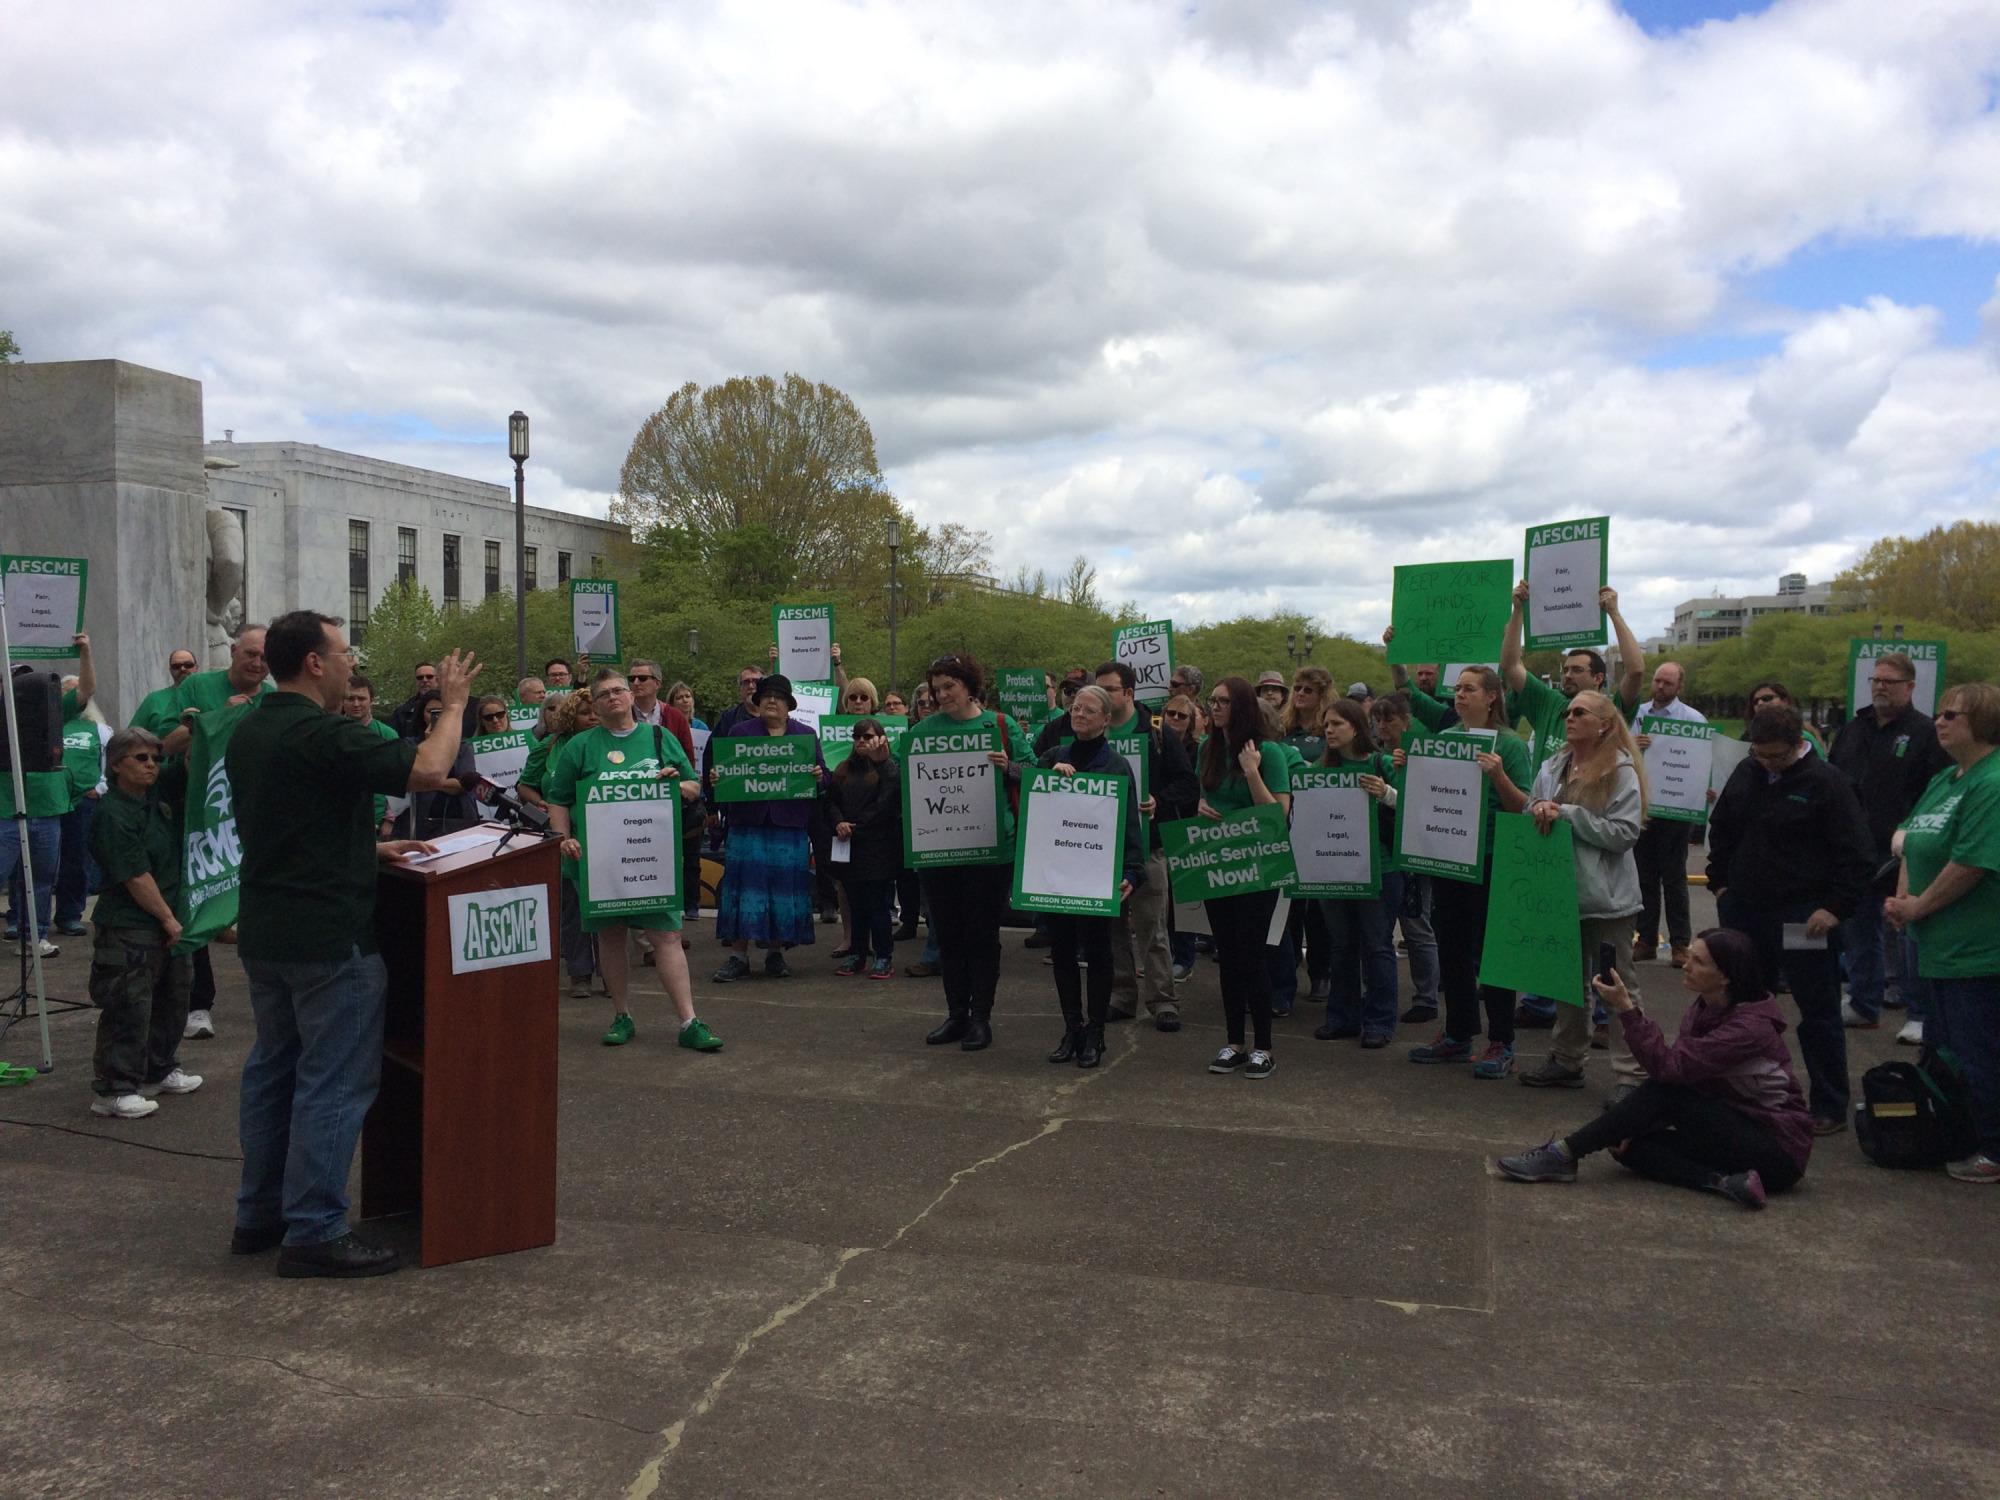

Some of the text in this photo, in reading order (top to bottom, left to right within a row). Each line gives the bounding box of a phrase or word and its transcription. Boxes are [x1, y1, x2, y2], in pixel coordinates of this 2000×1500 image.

[1532, 522, 1600, 546] AFSCME
[8, 560, 80, 575] AFSCME
[1449, 565, 1494, 588] YOUR
[575, 583, 614, 593] AFSCME
[779, 608, 829, 619] AFSCME
[1456, 612, 1488, 632] MY
[1118, 624, 1167, 640] AFSCME
[1119, 637, 1160, 657] CUTS
[1006, 673, 1034, 687] Protect
[1129, 662, 1166, 684] URT
[794, 685, 833, 697] SCME
[822, 726, 906, 742] RESCT
[1650, 721, 1716, 739] AFSCME
[473, 734, 527, 753] FSCME
[735, 742, 795, 757] Protect
[911, 734, 992, 753] AFSCME
[716, 762, 814, 777] Public Services
[917, 762, 989, 780] RESPECT
[587, 783, 671, 802] AFSCME
[745, 777, 787, 793] Now!
[939, 785, 965, 794] OUR
[1032, 774, 1119, 797] AFSCME
[1430, 785, 1460, 796] Workers
[924, 797, 970, 815] WORK
[1433, 805, 1462, 816] Services
[623, 817, 653, 828] Oregon
[1062, 819, 1099, 830] Revenue
[1330, 813, 1346, 821] Fair,
[1187, 817, 1261, 844] Protect
[1327, 832, 1350, 840] Legal,
[1425, 824, 1468, 837] Before Cuts
[626, 836, 652, 845] Needs
[1055, 839, 1103, 851] Before Cuts
[622, 855, 658, 865] Revenue,
[1167, 840, 1291, 871] Public Services
[1315, 849, 1362, 858] Sustainable.
[623, 874, 658, 883] Not Cuts
[1207, 863, 1260, 888] Now!
[598, 901, 627, 909] OREGON
[627, 898, 658, 907] COUNCIL
[1029, 896, 1060, 904] OREGON
[1061, 898, 1093, 906] COUNCIL
[467, 899, 538, 959] AFSCME
